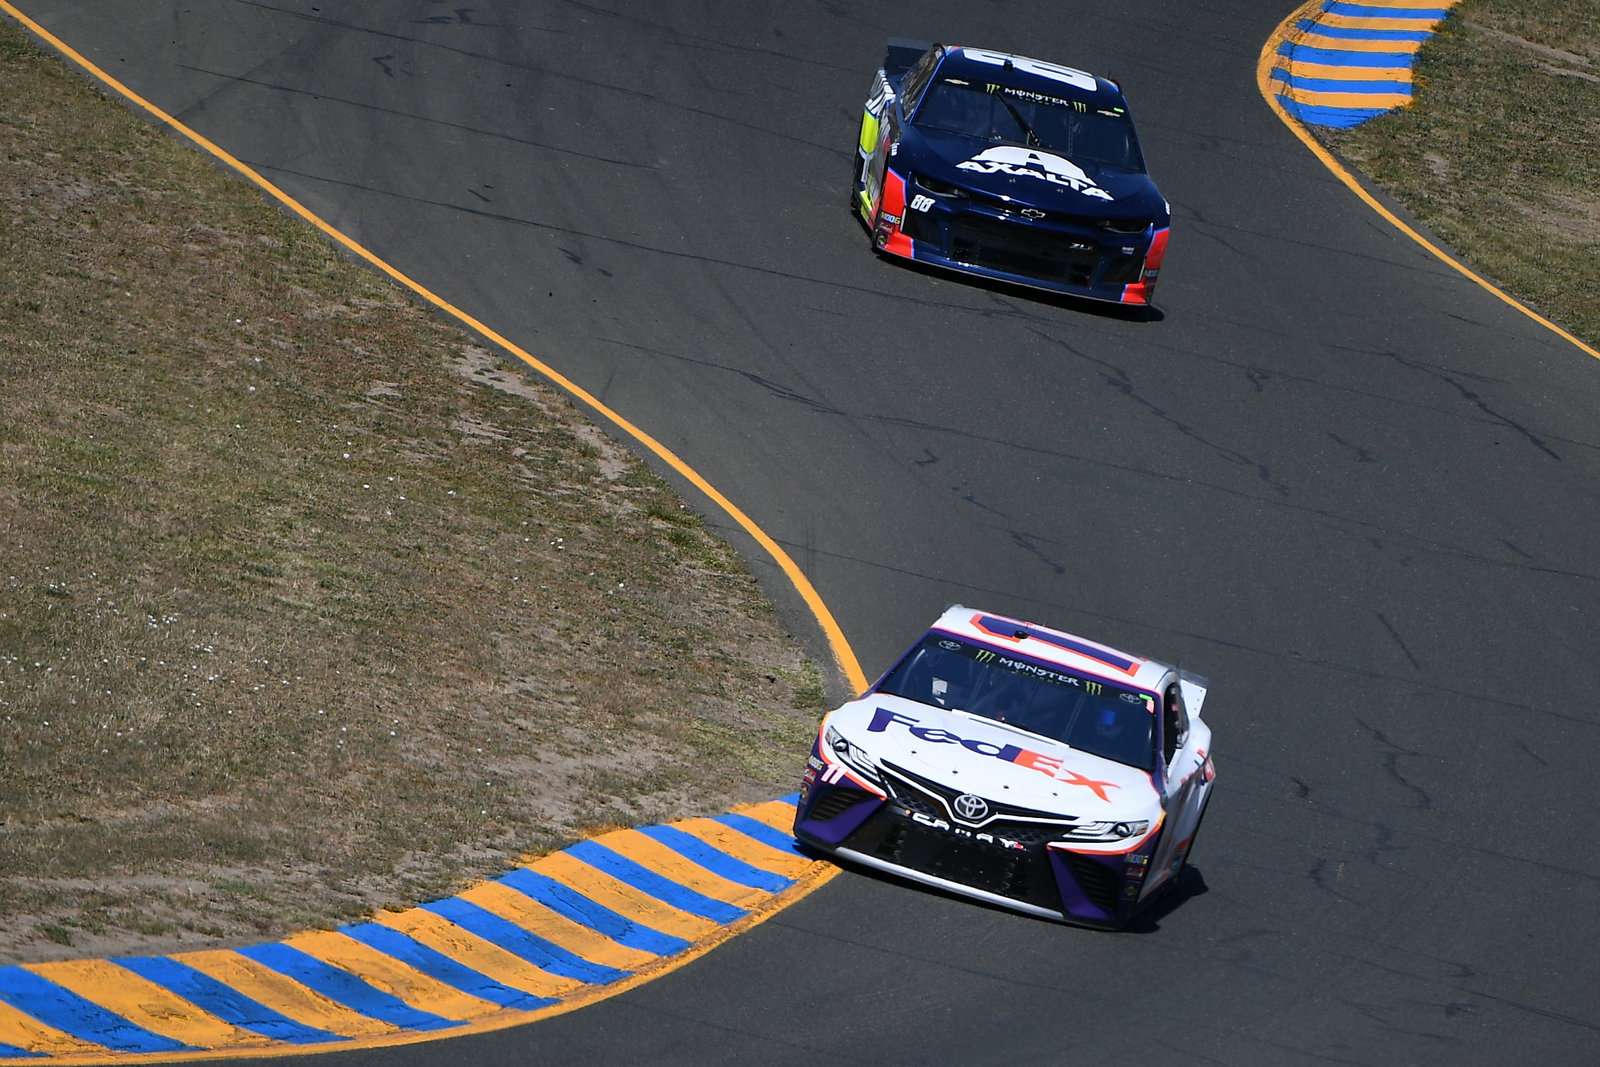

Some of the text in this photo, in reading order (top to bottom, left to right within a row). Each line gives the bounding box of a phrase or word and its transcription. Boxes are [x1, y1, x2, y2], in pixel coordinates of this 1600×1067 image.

[955, 160, 1115, 201] AXALTA
[910, 194, 936, 213] 88
[867, 707, 1122, 804] FedEx
[820, 763, 848, 785] 11
